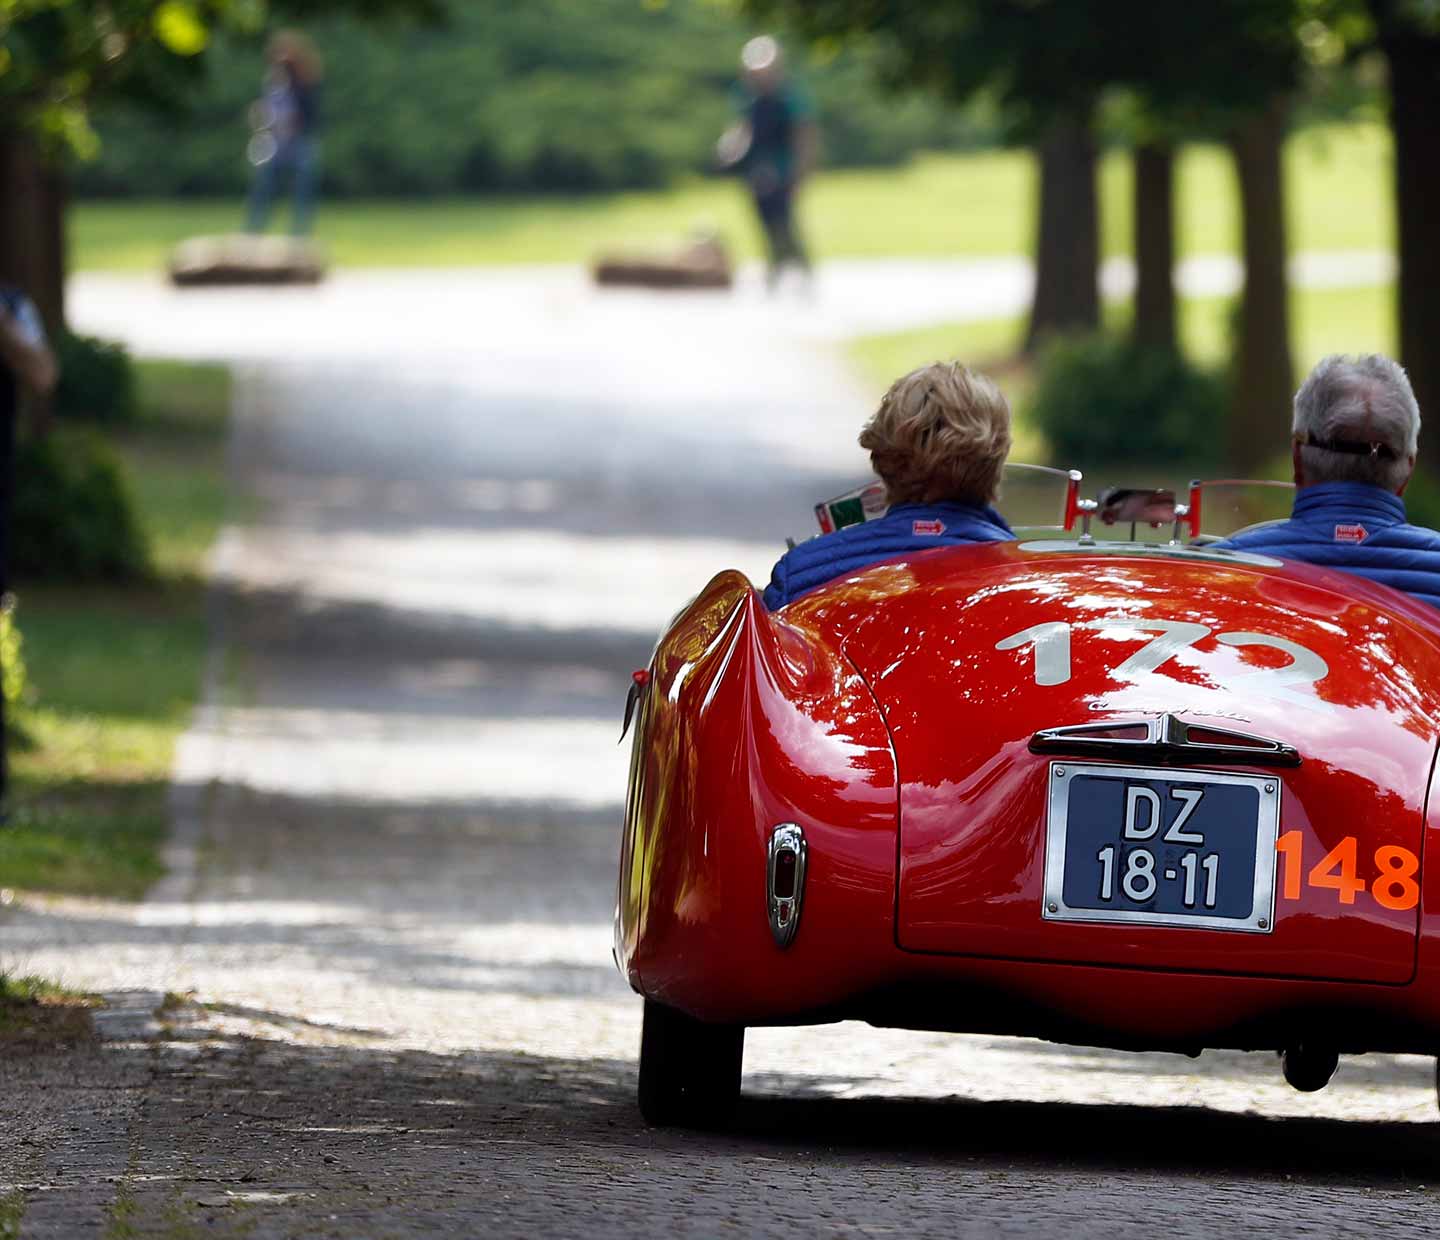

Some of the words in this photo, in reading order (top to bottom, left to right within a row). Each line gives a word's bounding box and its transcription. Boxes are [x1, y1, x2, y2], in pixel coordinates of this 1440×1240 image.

[995, 618, 1330, 704] 172
[1124, 786, 1204, 843] DZ
[1098, 847, 1219, 907] 18-11
[1275, 830, 1420, 911] 148
